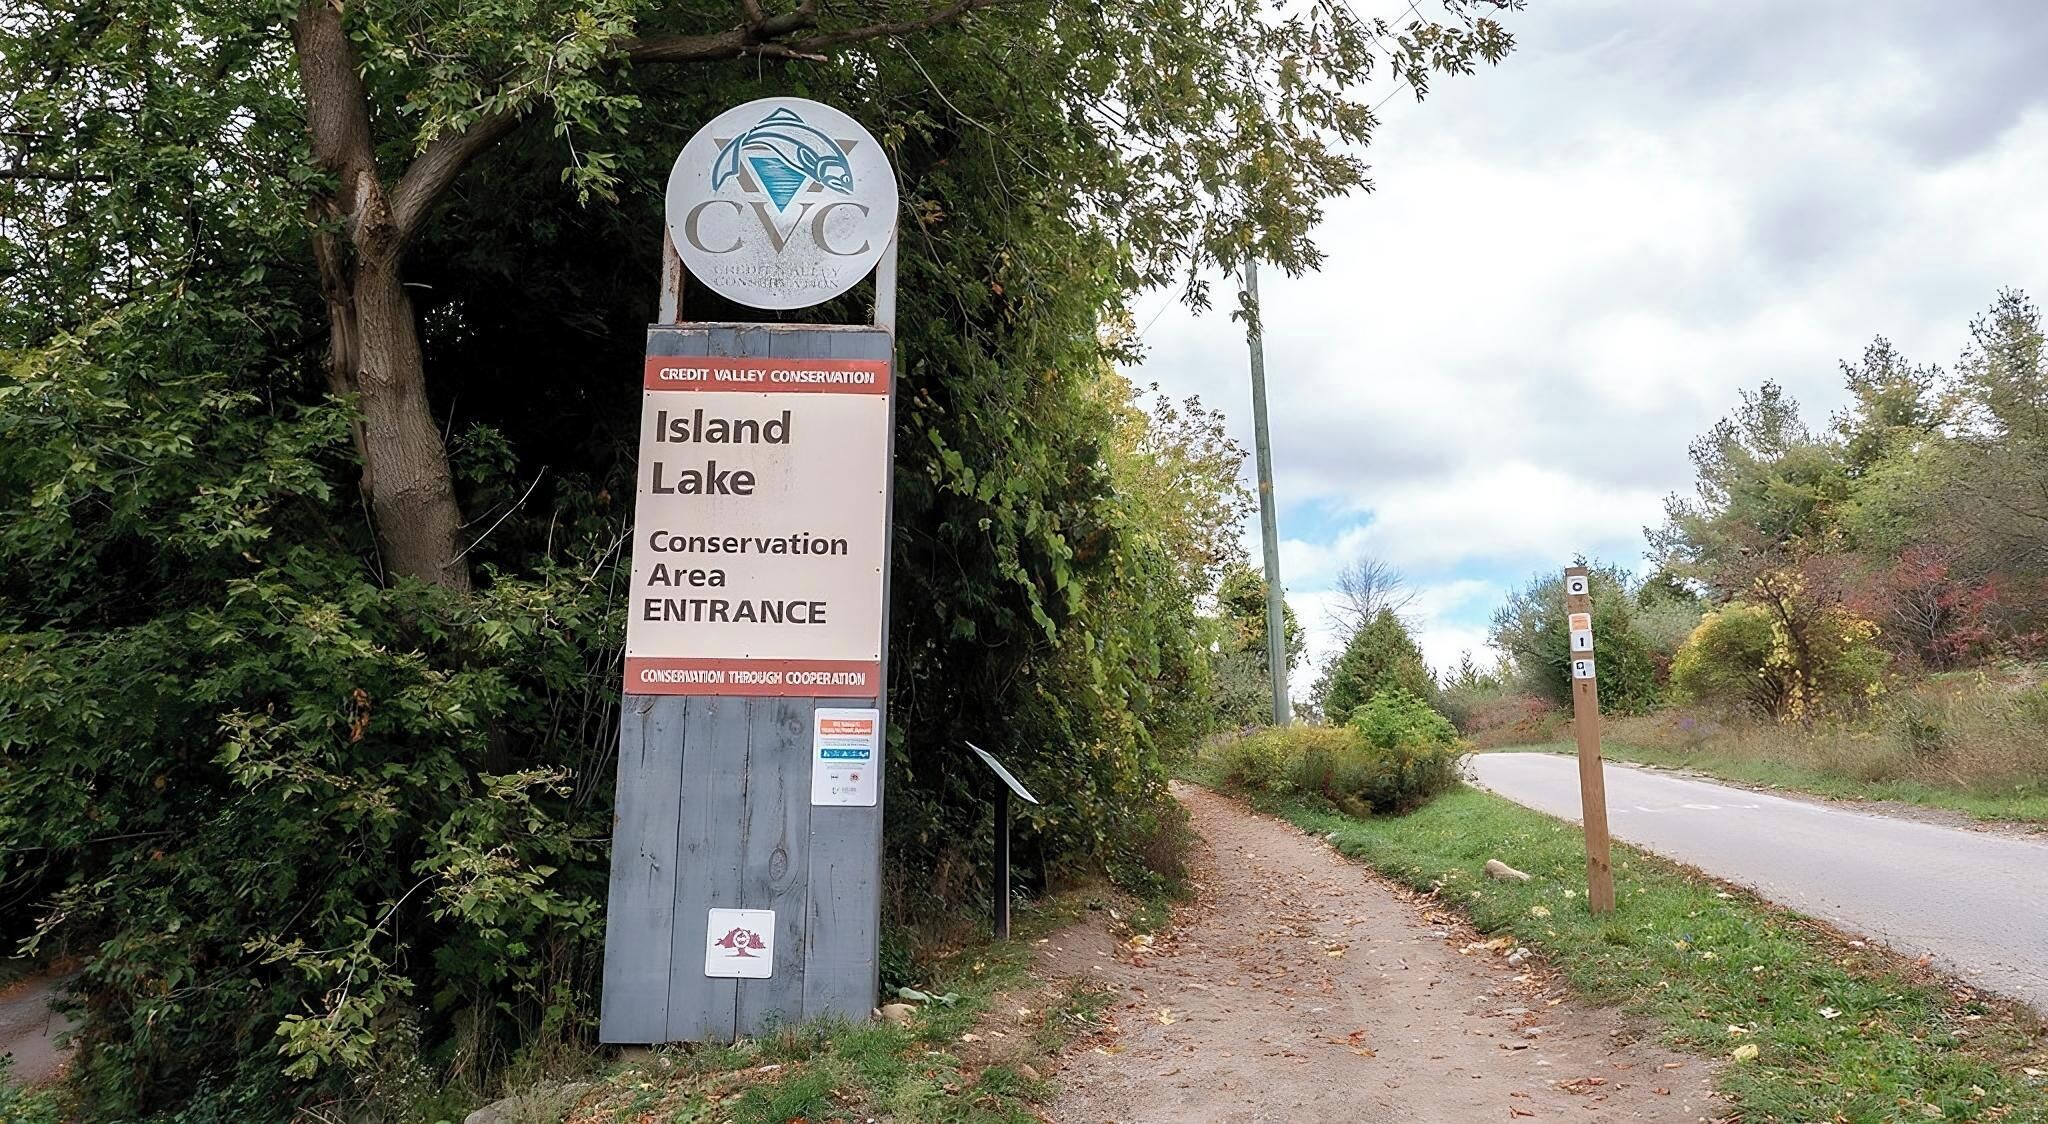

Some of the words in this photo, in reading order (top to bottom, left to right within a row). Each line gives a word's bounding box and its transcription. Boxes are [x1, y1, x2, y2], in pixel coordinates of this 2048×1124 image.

[685, 199, 871, 256] CVC
[713, 277, 839, 289] CONSATION
[777, 266, 840, 277] ALLY
[659, 367, 710, 381] CREDIT
[714, 368, 766, 382] VALLEY
[770, 370, 875, 384] CONSERVATION
[655, 408, 792, 444] Island
[652, 460, 756, 495] Lake
[649, 530, 848, 555] Conservation
[647, 563, 726, 587] Area
[643, 598, 827, 624] ENTRANCE
[640, 669, 725, 683] CONSERVATION
[728, 671, 783, 685] THROUGH
[785, 671, 866, 686] COOPERATION
